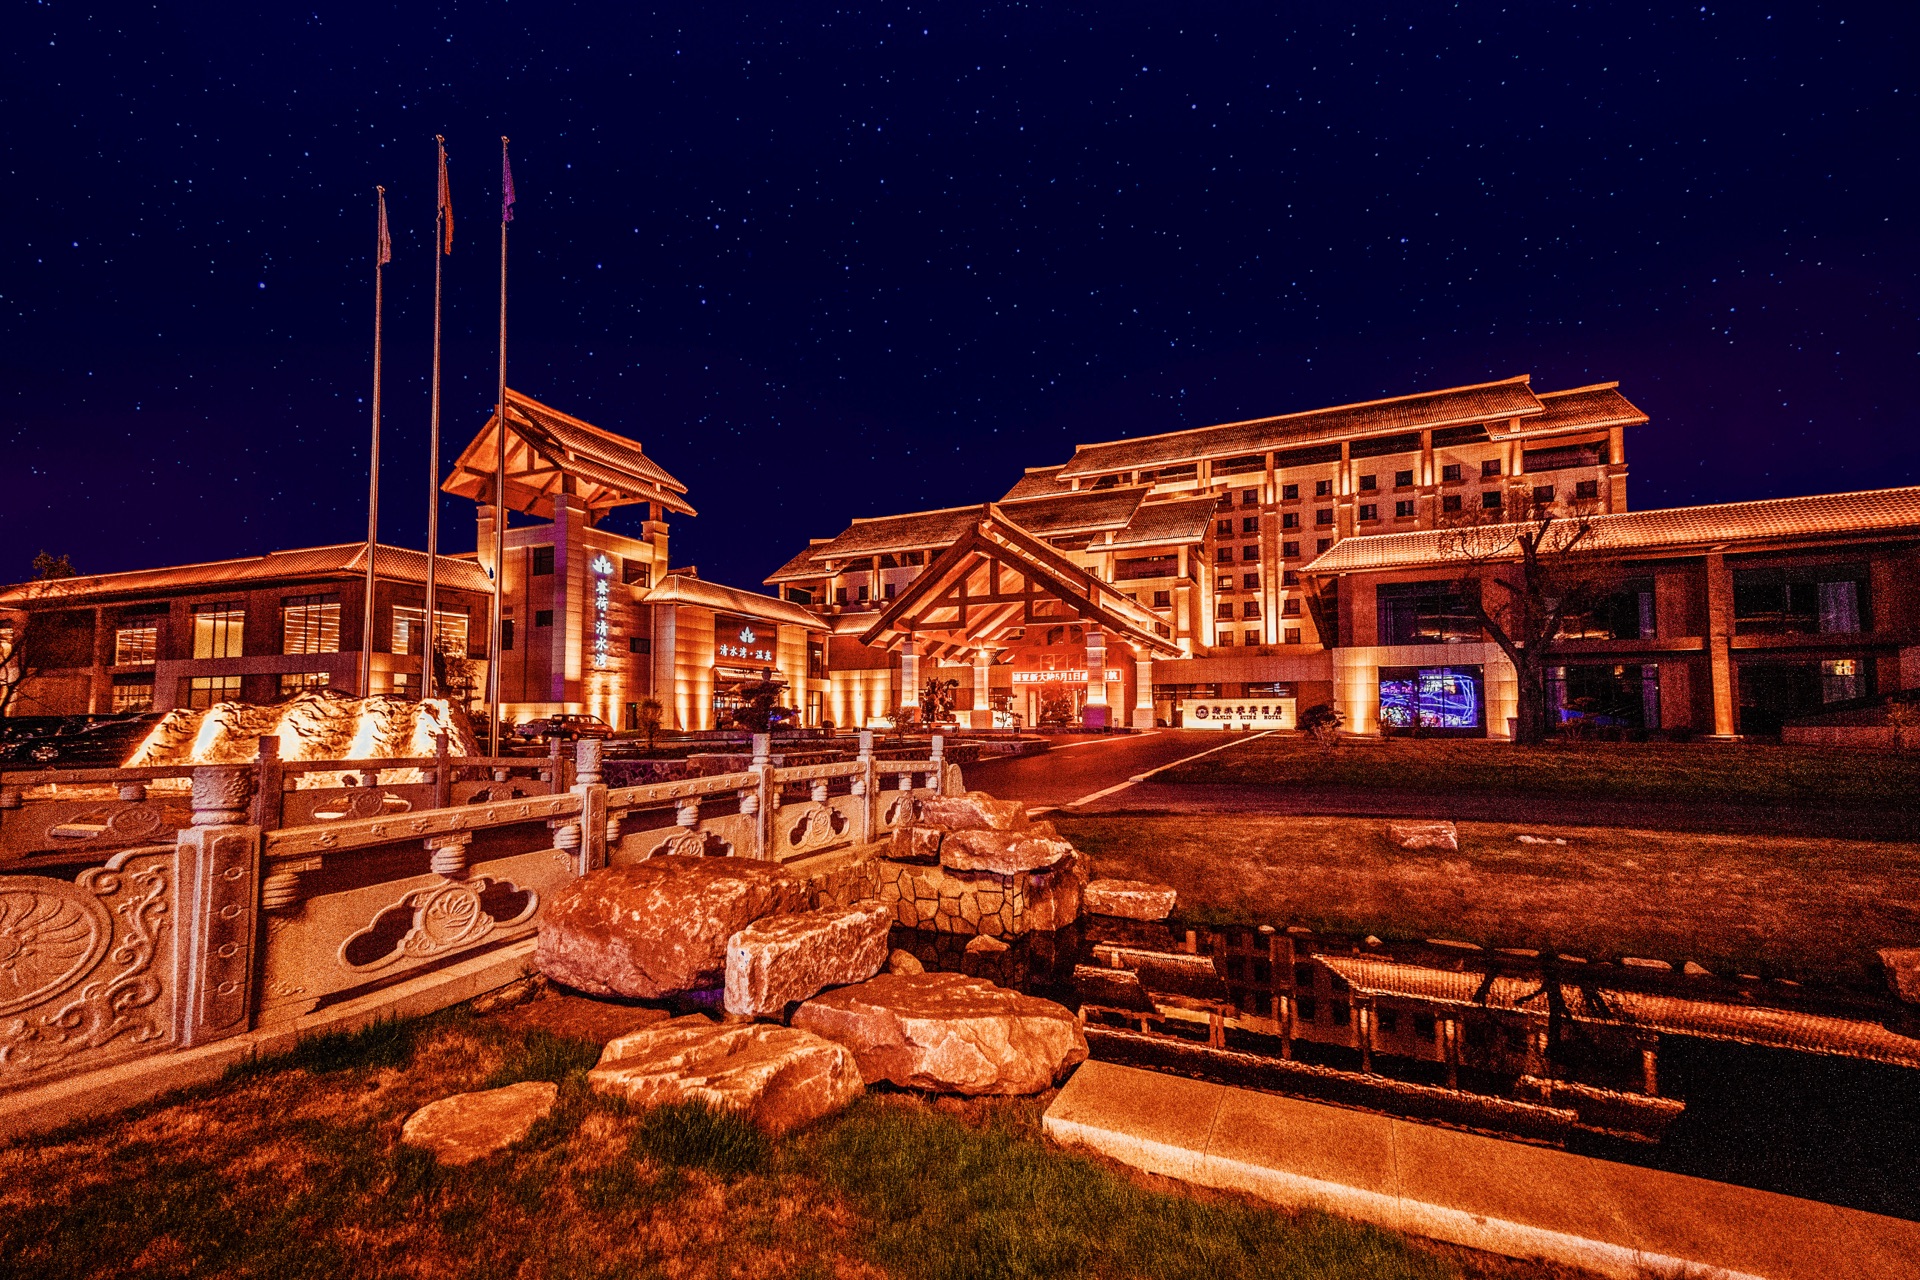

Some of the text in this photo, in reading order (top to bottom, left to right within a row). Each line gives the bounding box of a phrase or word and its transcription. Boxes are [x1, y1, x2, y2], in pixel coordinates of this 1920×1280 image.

[719, 644, 772, 661] 清水湾·温泉
